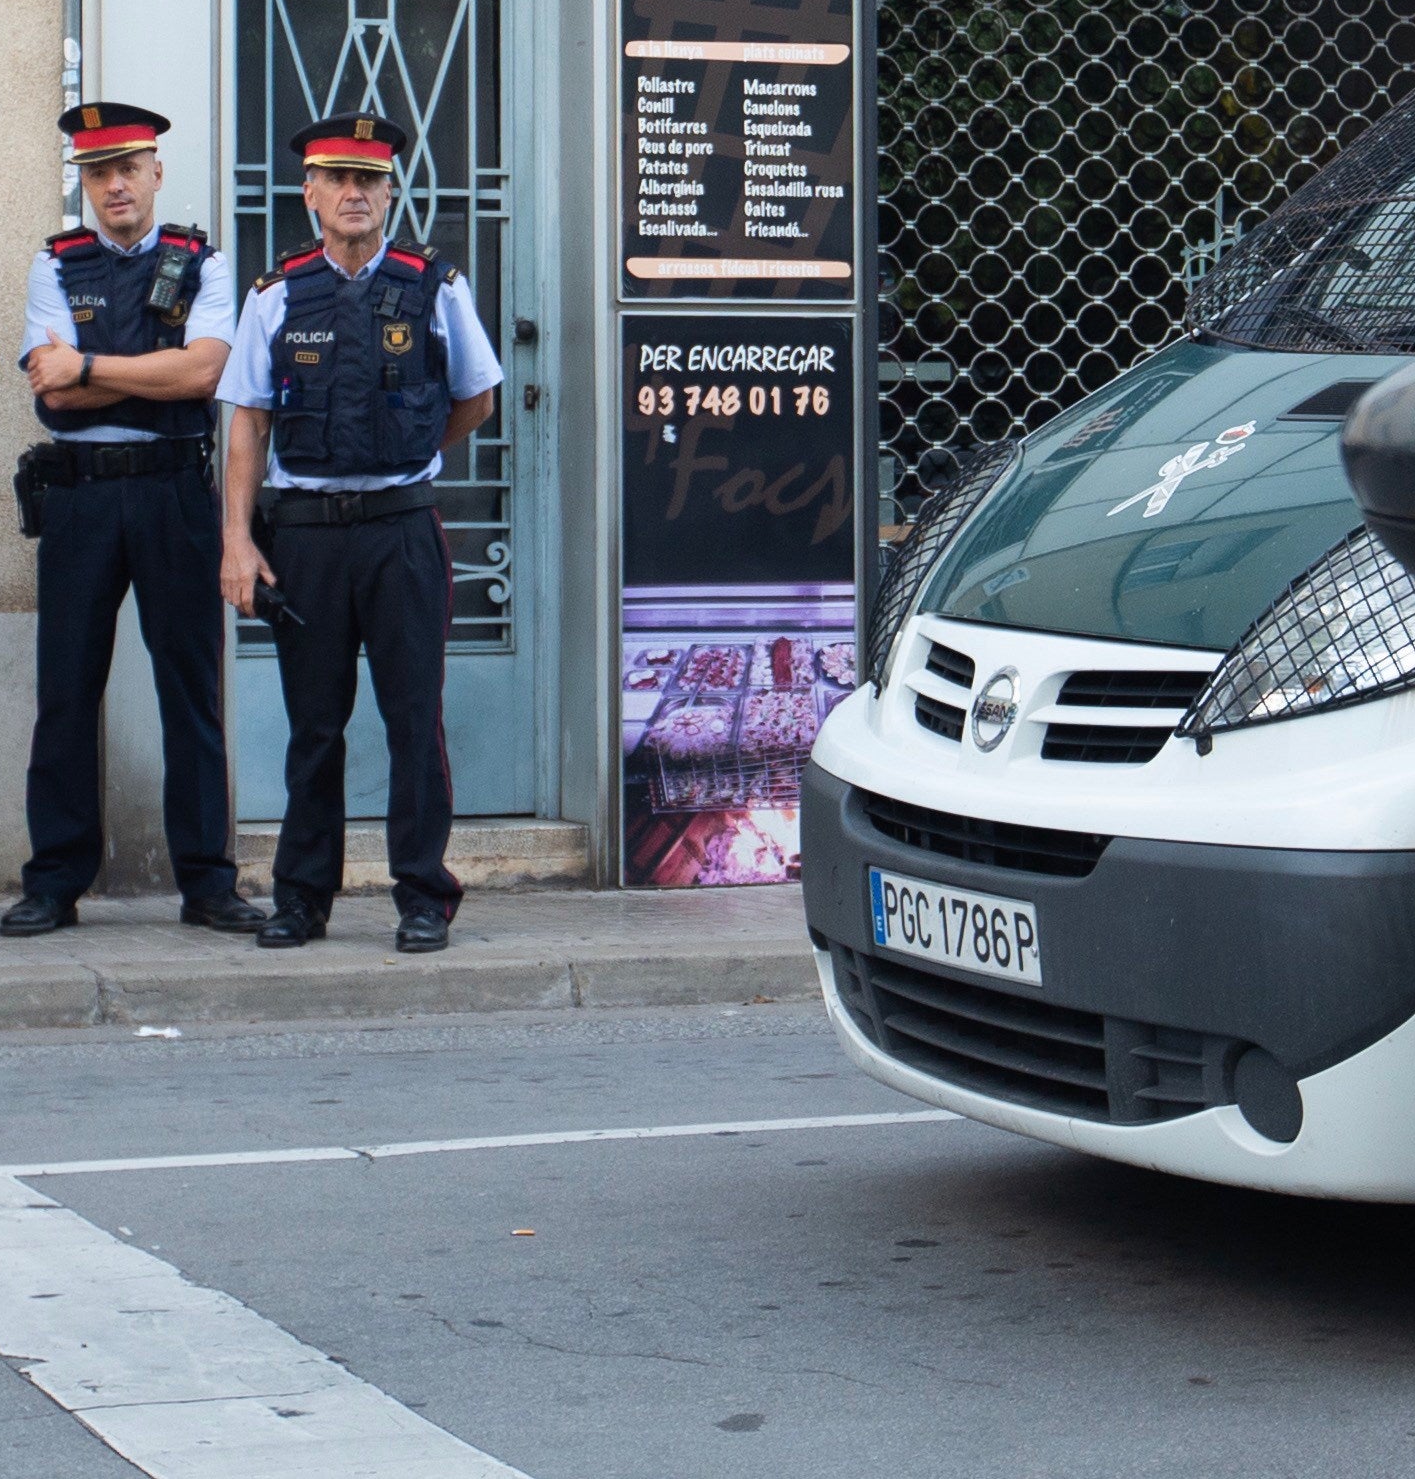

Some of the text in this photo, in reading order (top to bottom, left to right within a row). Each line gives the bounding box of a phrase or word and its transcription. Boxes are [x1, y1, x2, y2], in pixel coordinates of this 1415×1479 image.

[638, 76, 695, 94] Pollastre
[743, 79, 817, 97] Macarrons
[638, 97, 675, 114] Conill
[743, 99, 800, 116] Canelons
[638, 117, 707, 135] Botifarres
[744, 120, 812, 138] Esqueixada
[638, 138, 713, 158] Peus de porc
[744, 141, 791, 157] Trinxat
[638, 158, 689, 175] Patates
[744, 160, 807, 179] Croquetes
[744, 180, 844, 198] Ensaladilla rusa
[638, 199, 698, 216] Carbassó
[744, 200, 786, 218] Galtes
[68, 295, 106, 308] OLICIA
[285, 331, 335, 343] POLICIA
[640, 344, 835, 375] PER ENCARREGAR
[638, 385, 675, 416] 93
[684, 385, 741, 416] 748
